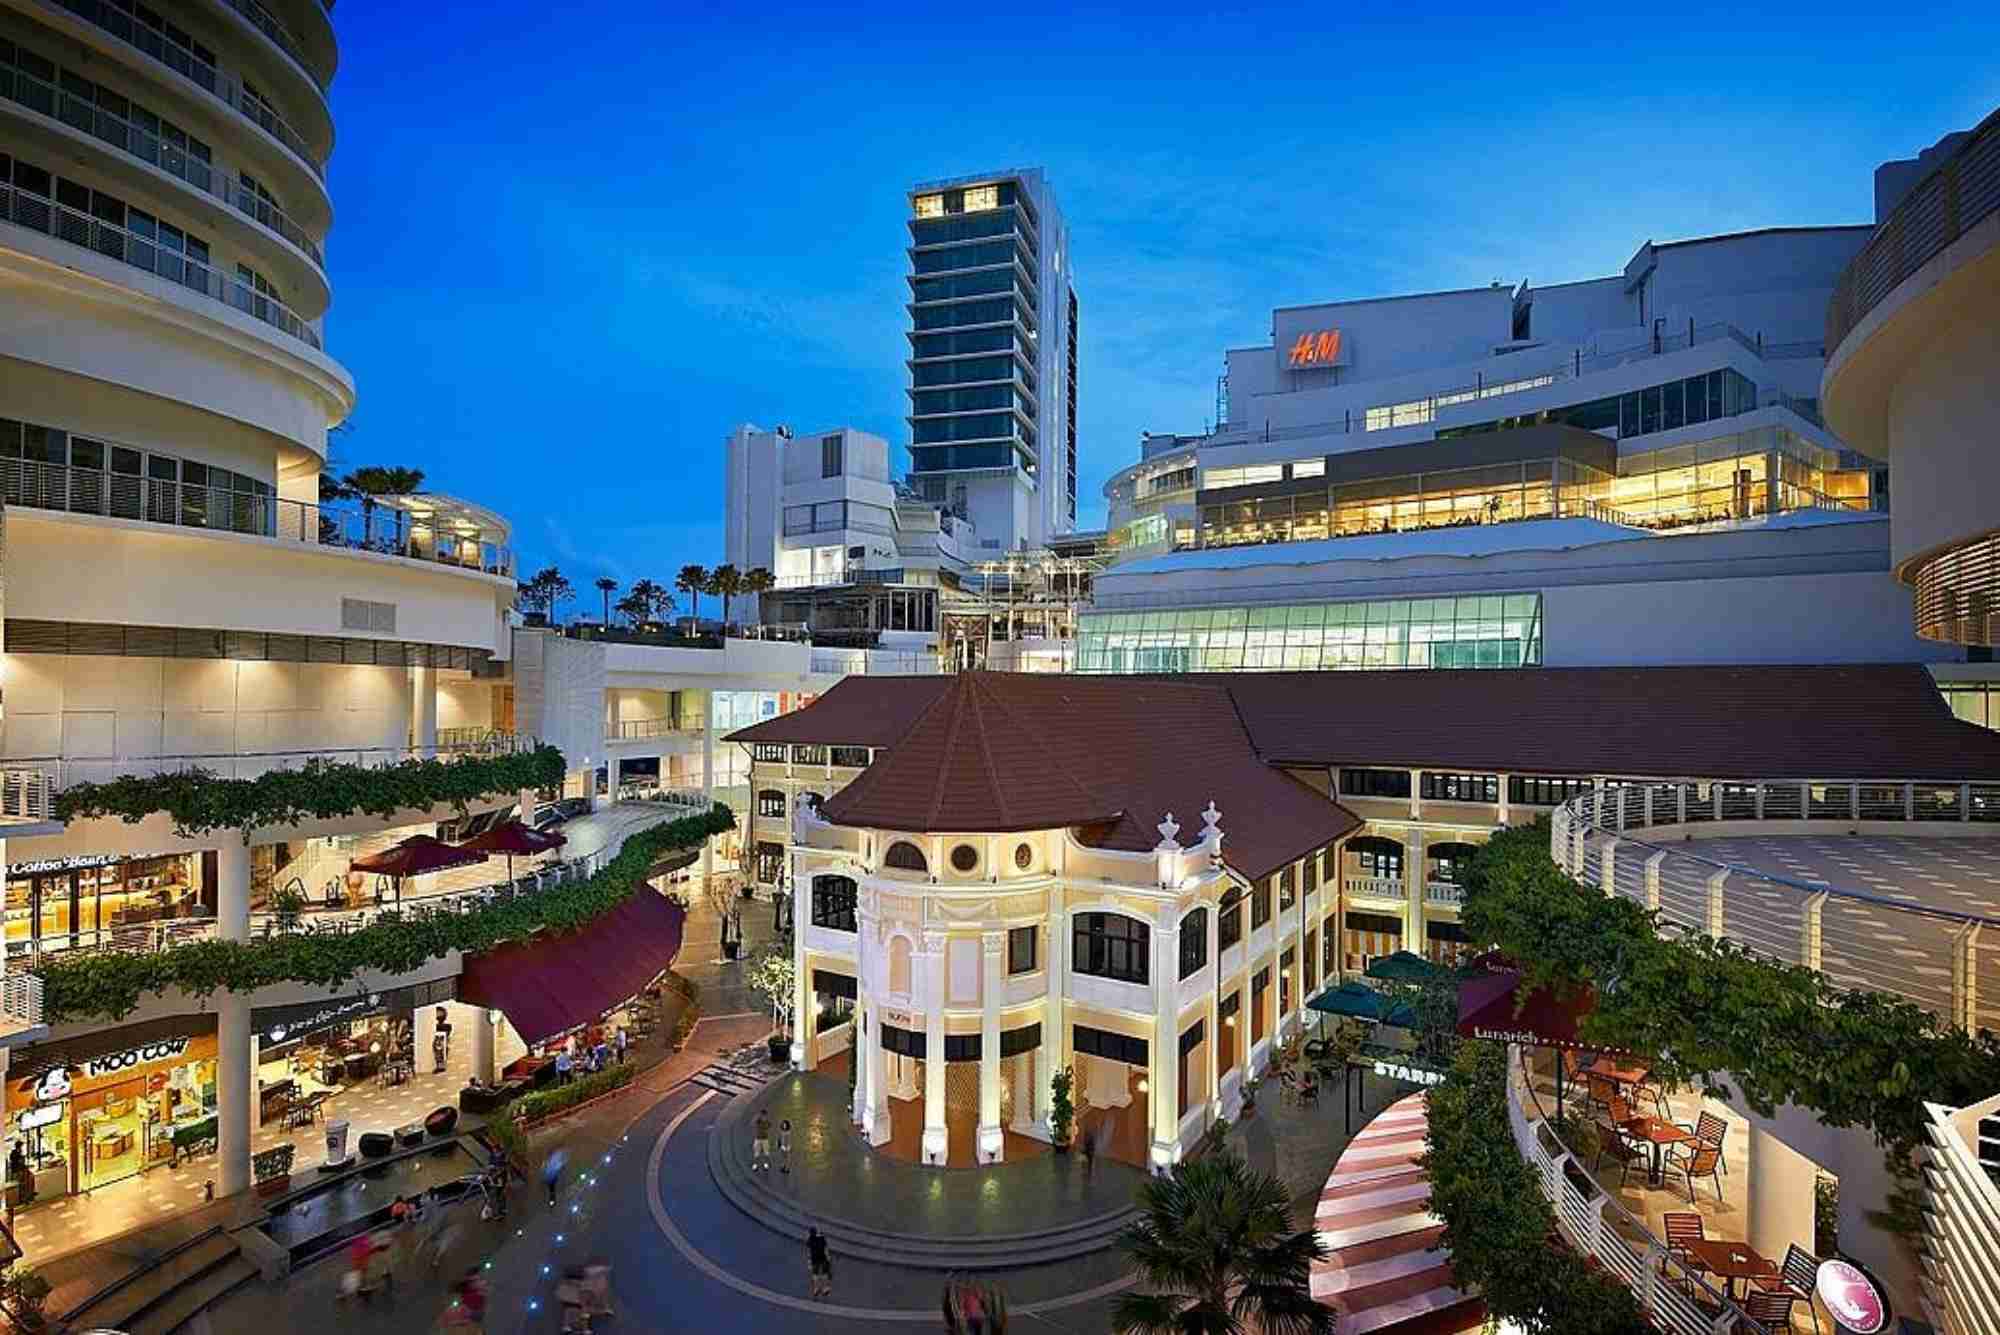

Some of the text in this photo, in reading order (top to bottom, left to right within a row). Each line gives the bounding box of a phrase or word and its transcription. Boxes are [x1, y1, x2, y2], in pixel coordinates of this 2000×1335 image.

[1288, 330, 1341, 367] H&M
[11, 859, 62, 875] Coffee
[90, 1037, 187, 1075] MOO COW
